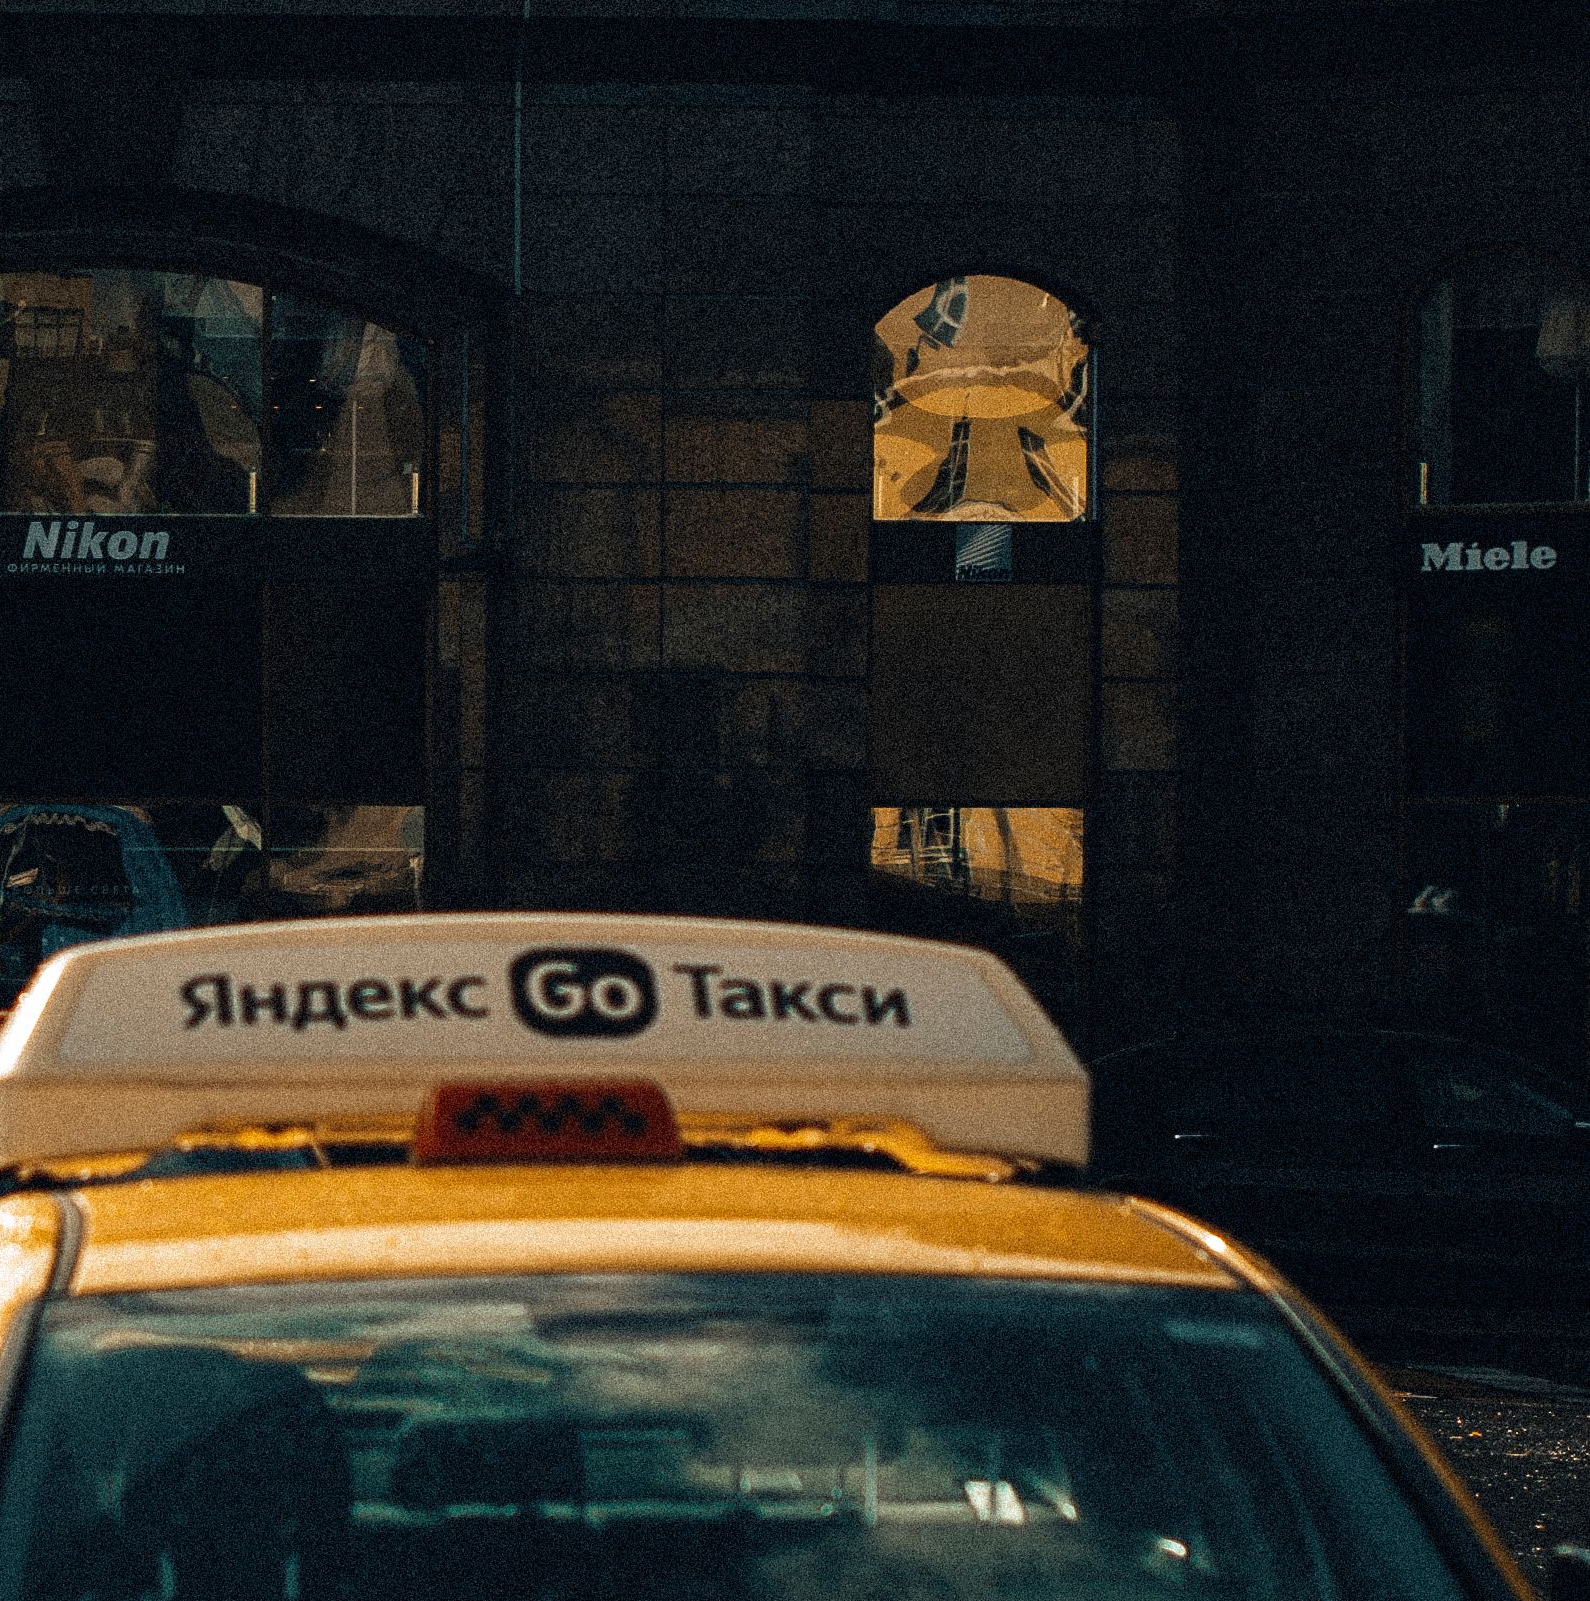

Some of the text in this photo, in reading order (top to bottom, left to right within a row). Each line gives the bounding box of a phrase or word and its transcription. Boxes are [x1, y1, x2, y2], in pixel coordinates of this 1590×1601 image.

[22, 520, 170, 560] Nikon
[1421, 540, 1558, 571] Miele
[7, 563, 186, 574] ФИРМЕННЫЙ МАГАЗИН
[179, 959, 912, 1032] Яндекс Go Такси
